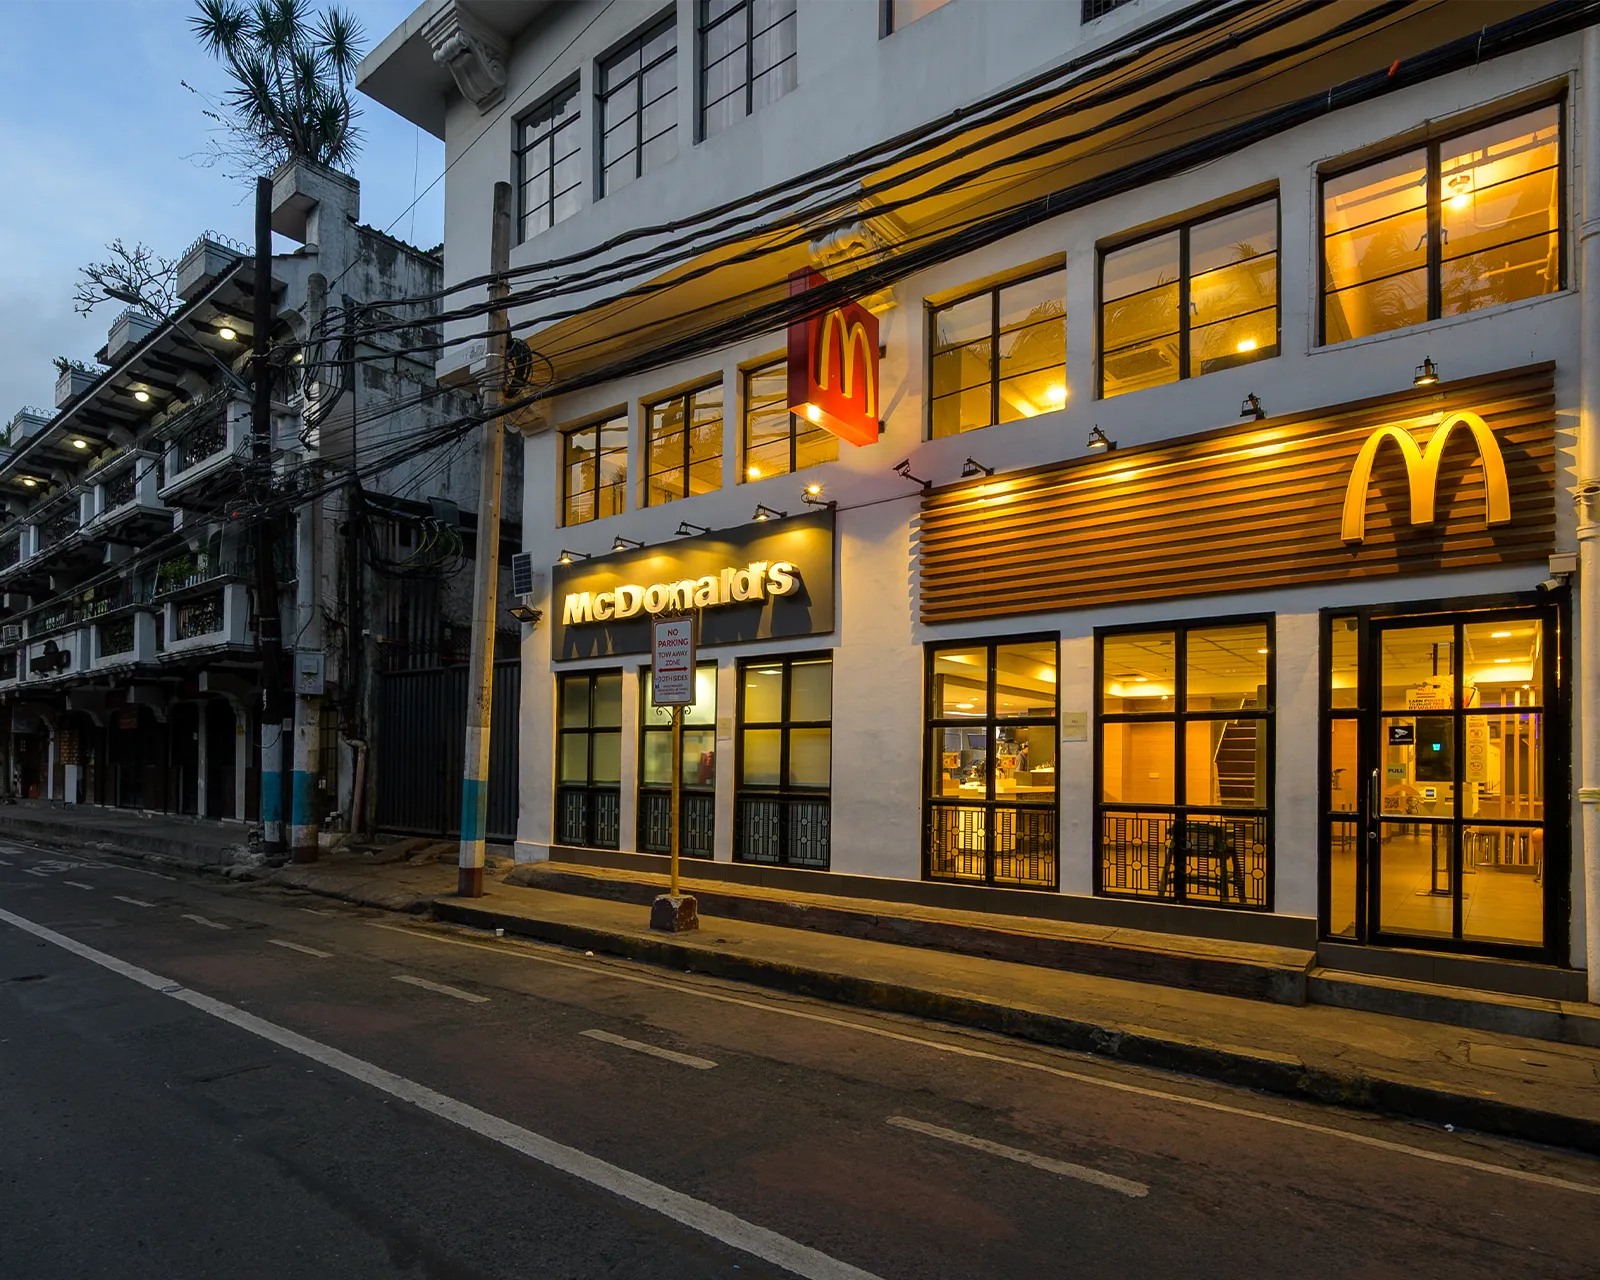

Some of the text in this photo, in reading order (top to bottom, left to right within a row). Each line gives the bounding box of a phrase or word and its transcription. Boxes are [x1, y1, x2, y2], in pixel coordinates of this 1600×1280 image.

[562, 560, 800, 626] McDonald's
[667, 628, 679, 637] NO
[657, 638, 689, 648] PARKING
[672, 650, 688, 658] AWAY
[673, 674, 688, 682] SIDES
